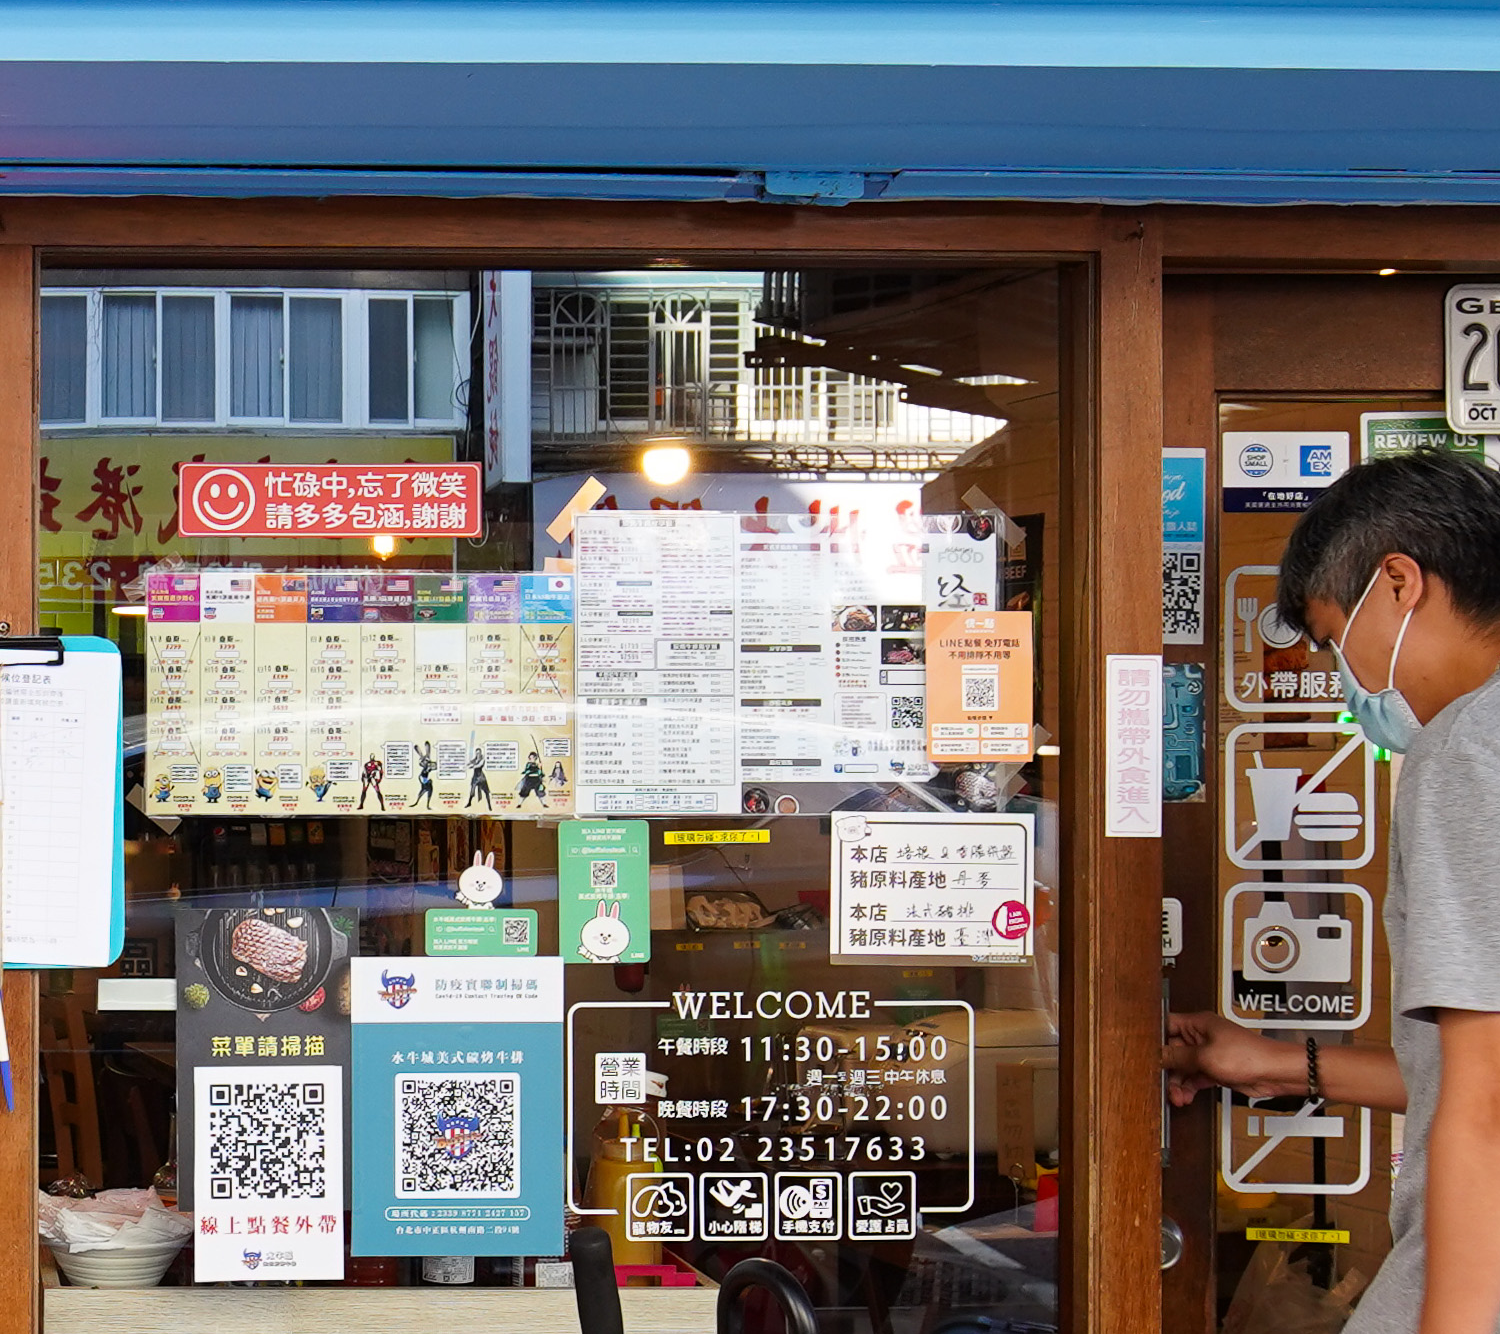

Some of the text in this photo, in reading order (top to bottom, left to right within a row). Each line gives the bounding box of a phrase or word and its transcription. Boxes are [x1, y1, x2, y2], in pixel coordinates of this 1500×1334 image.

[1468, 407, 1498, 421] OCT
[1373, 432, 1479, 450] REVIEW US
[1244, 459, 1269, 468] SMALL
[1246, 453, 1267, 461] SHOP
[1116, 668, 1151, 825] 請勿攜帶外食進入
[850, 844, 888, 864] 本店
[850, 870, 947, 889] 豬原料產地
[849, 903, 888, 922] 本店
[849, 928, 947, 947] 豬原料產地
[672, 990, 872, 1020] WELCOME
[1237, 992, 1355, 1015] WELCOME
[211, 1034, 326, 1058] 菜單請掃描
[656, 1035, 949, 1062] 午餐時段 11:30-15:00
[599, 1057, 642, 1078] 營業
[599, 1080, 642, 1101] 時間
[656, 1095, 949, 1122] 晚餐時段 17:30-22:00
[619, 1136, 927, 1163] TEL:02 23517633
[200, 1214, 338, 1236] 線上點餐外帶
